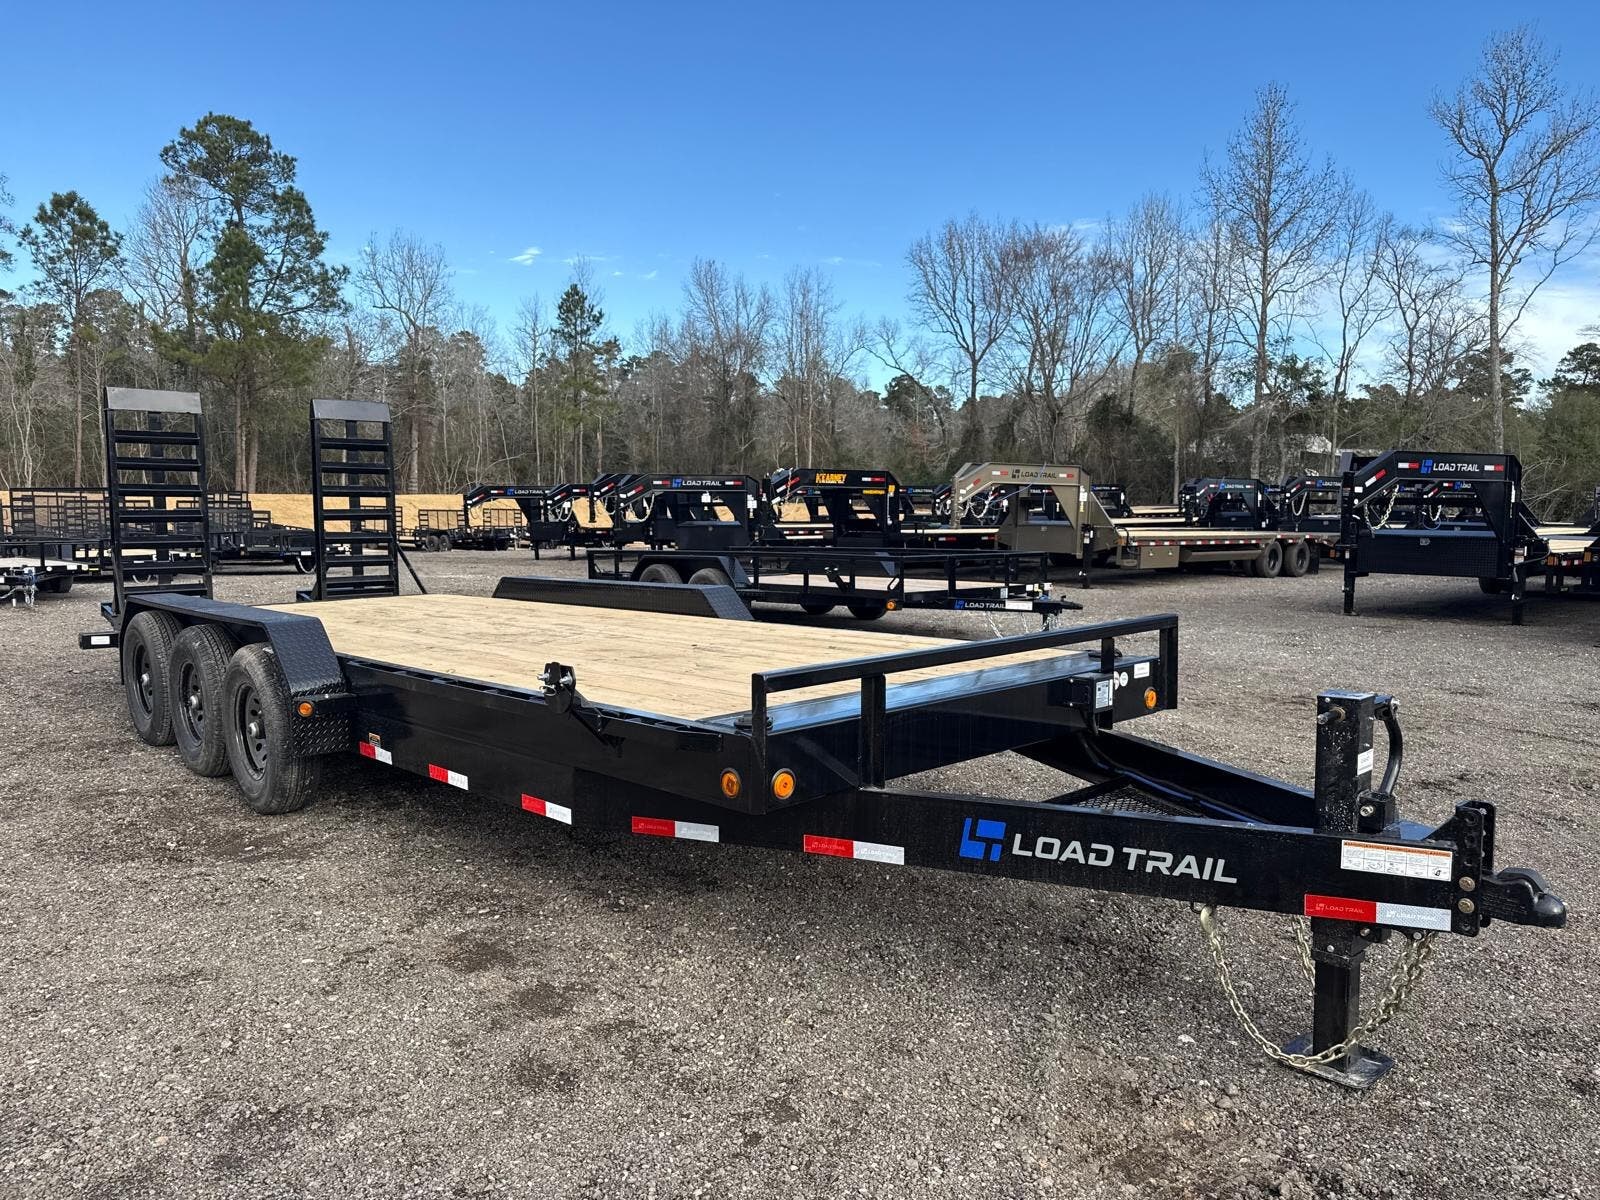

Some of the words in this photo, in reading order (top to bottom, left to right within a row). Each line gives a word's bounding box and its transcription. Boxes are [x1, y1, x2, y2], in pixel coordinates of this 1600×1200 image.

[1433, 462, 1456, 471] LOAD
[1456, 463, 1480, 472] TRAIL
[815, 473, 847, 483] KEARNEY
[1012, 833, 1115, 867] LOAD
[1122, 847, 1238, 884] TRAIL
[1345, 906, 1365, 914] TRAIL
